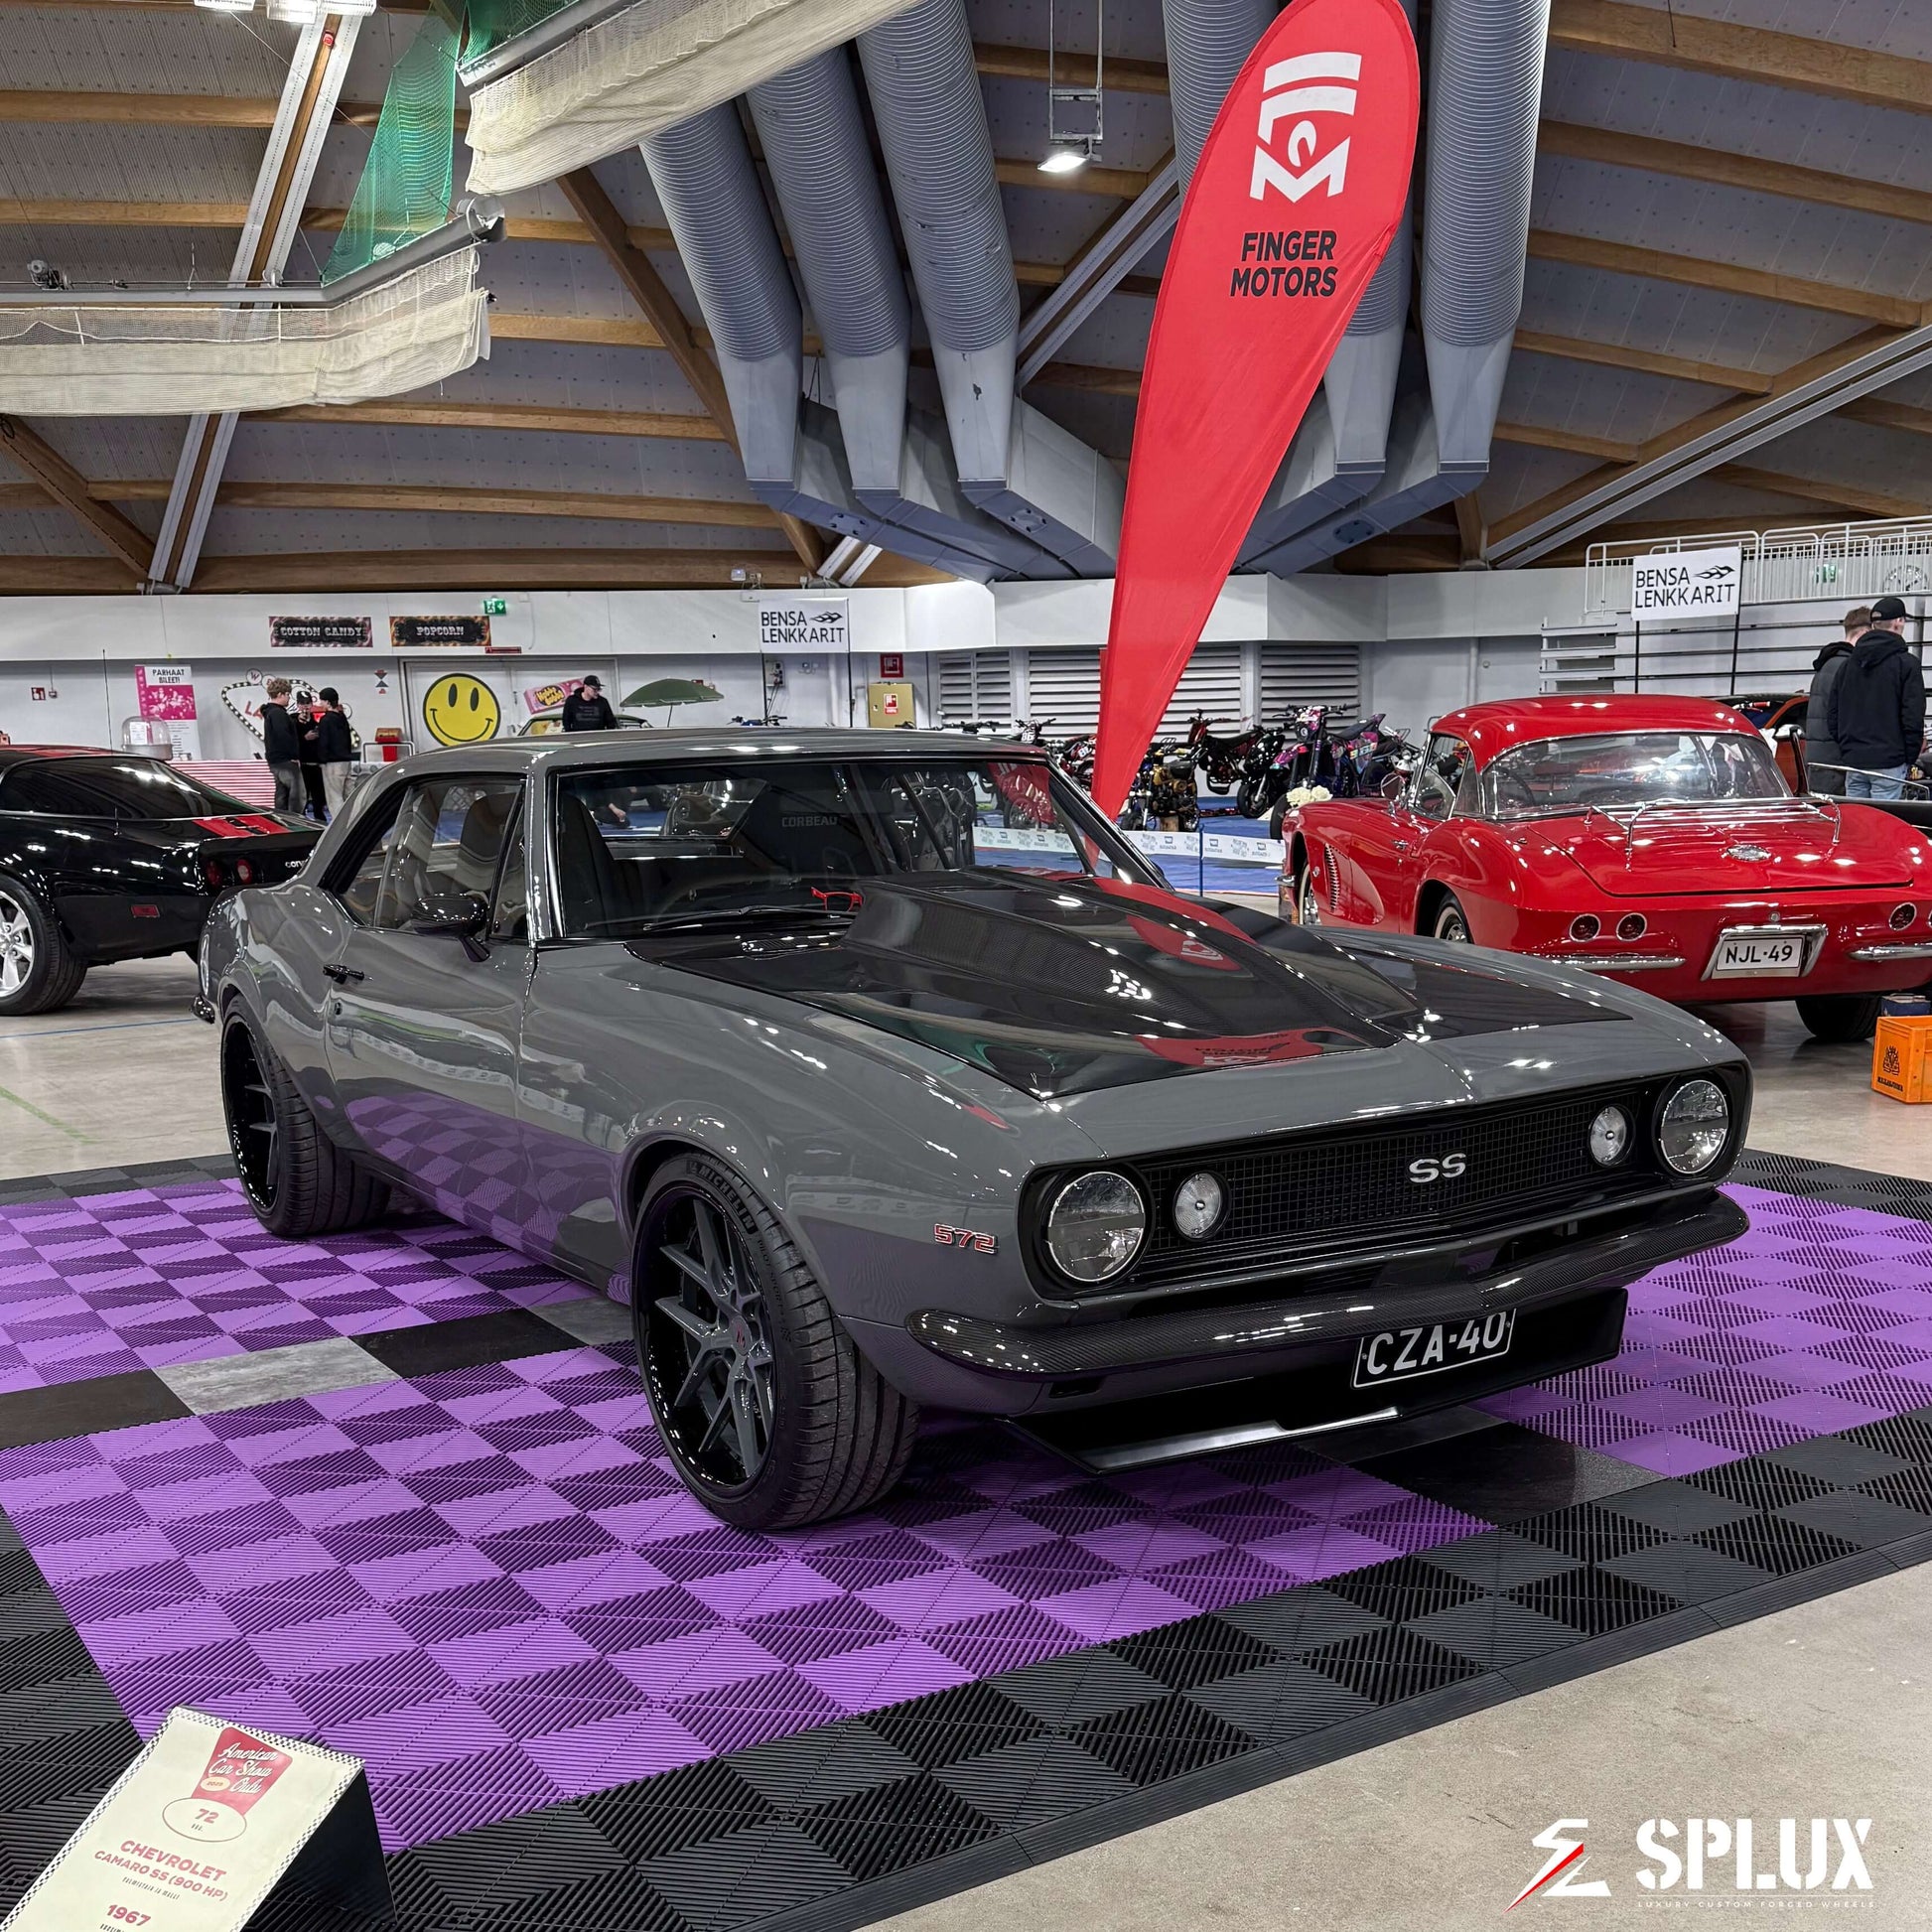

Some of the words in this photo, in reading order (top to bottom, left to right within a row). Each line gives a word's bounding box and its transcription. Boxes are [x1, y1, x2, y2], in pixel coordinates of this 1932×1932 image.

[1241, 230, 1336, 261] FINGER
[1230, 267, 1337, 297] MOTORS
[1635, 566, 1690, 588] BENSA
[1635, 583, 1735, 609] LENKKARIT
[280, 626, 321, 636] COTTON
[324, 626, 362, 636] CANDY
[416, 625, 465, 636] POPCORN
[760, 611, 807, 626] BENSA
[761, 627, 845, 643] LENKKARIT
[781, 815, 839, 827] CORBEAU
[1409, 1153, 1466, 1183] SS
[698, 1165, 756, 1229] MICHELIN
[934, 1223, 997, 1255] 572
[1365, 1311, 1507, 1376] CZA-40
[195, 1808, 219, 1824] 72
[120, 1840, 227, 1882] CHEVROLET
[94, 1851, 151, 1874] CAMARO
[149, 1868, 170, 1881] SS
[168, 1875, 204, 1892] (900
[202, 1885, 228, 1902] HP)
[106, 1904, 152, 1926] 1967
